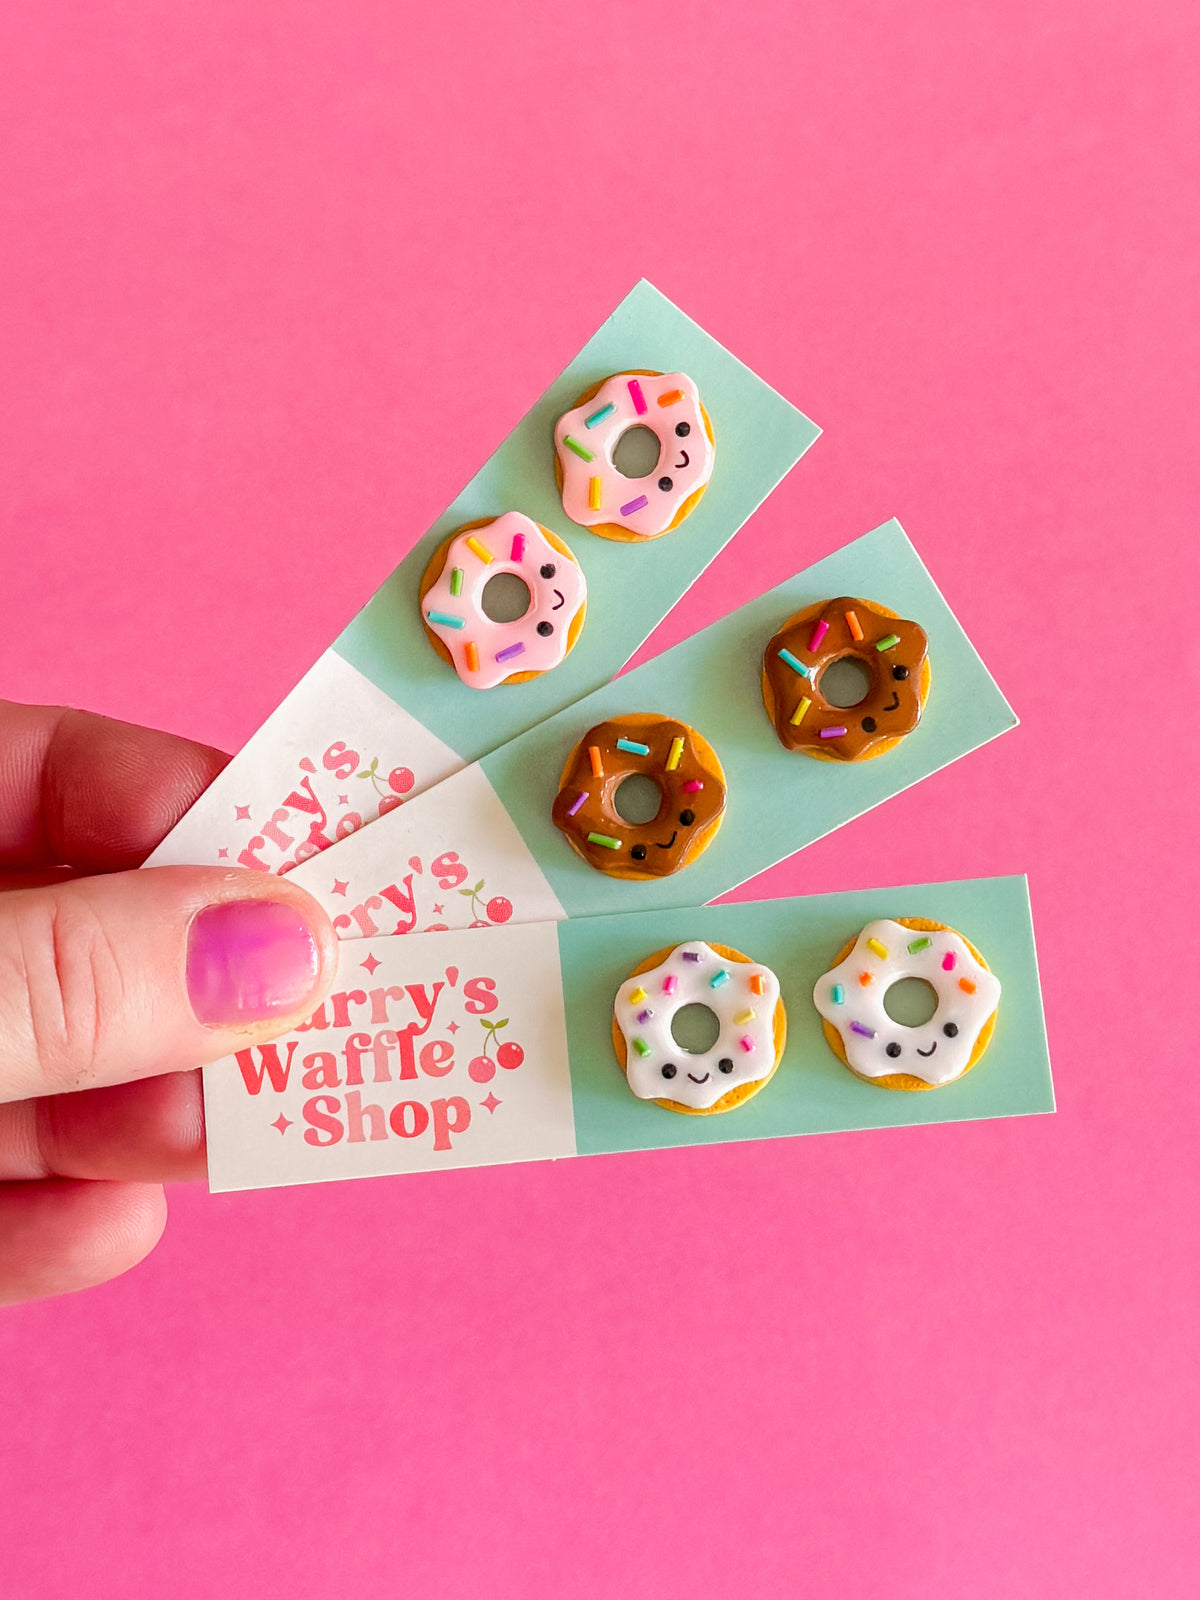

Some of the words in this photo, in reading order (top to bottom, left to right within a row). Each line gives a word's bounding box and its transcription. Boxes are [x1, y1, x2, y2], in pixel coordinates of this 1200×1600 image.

[237, 741, 360, 872] rry's
[294, 966, 499, 1035] rry's
[234, 1026, 456, 1096] Waffle
[302, 1090, 472, 1151] Shop
